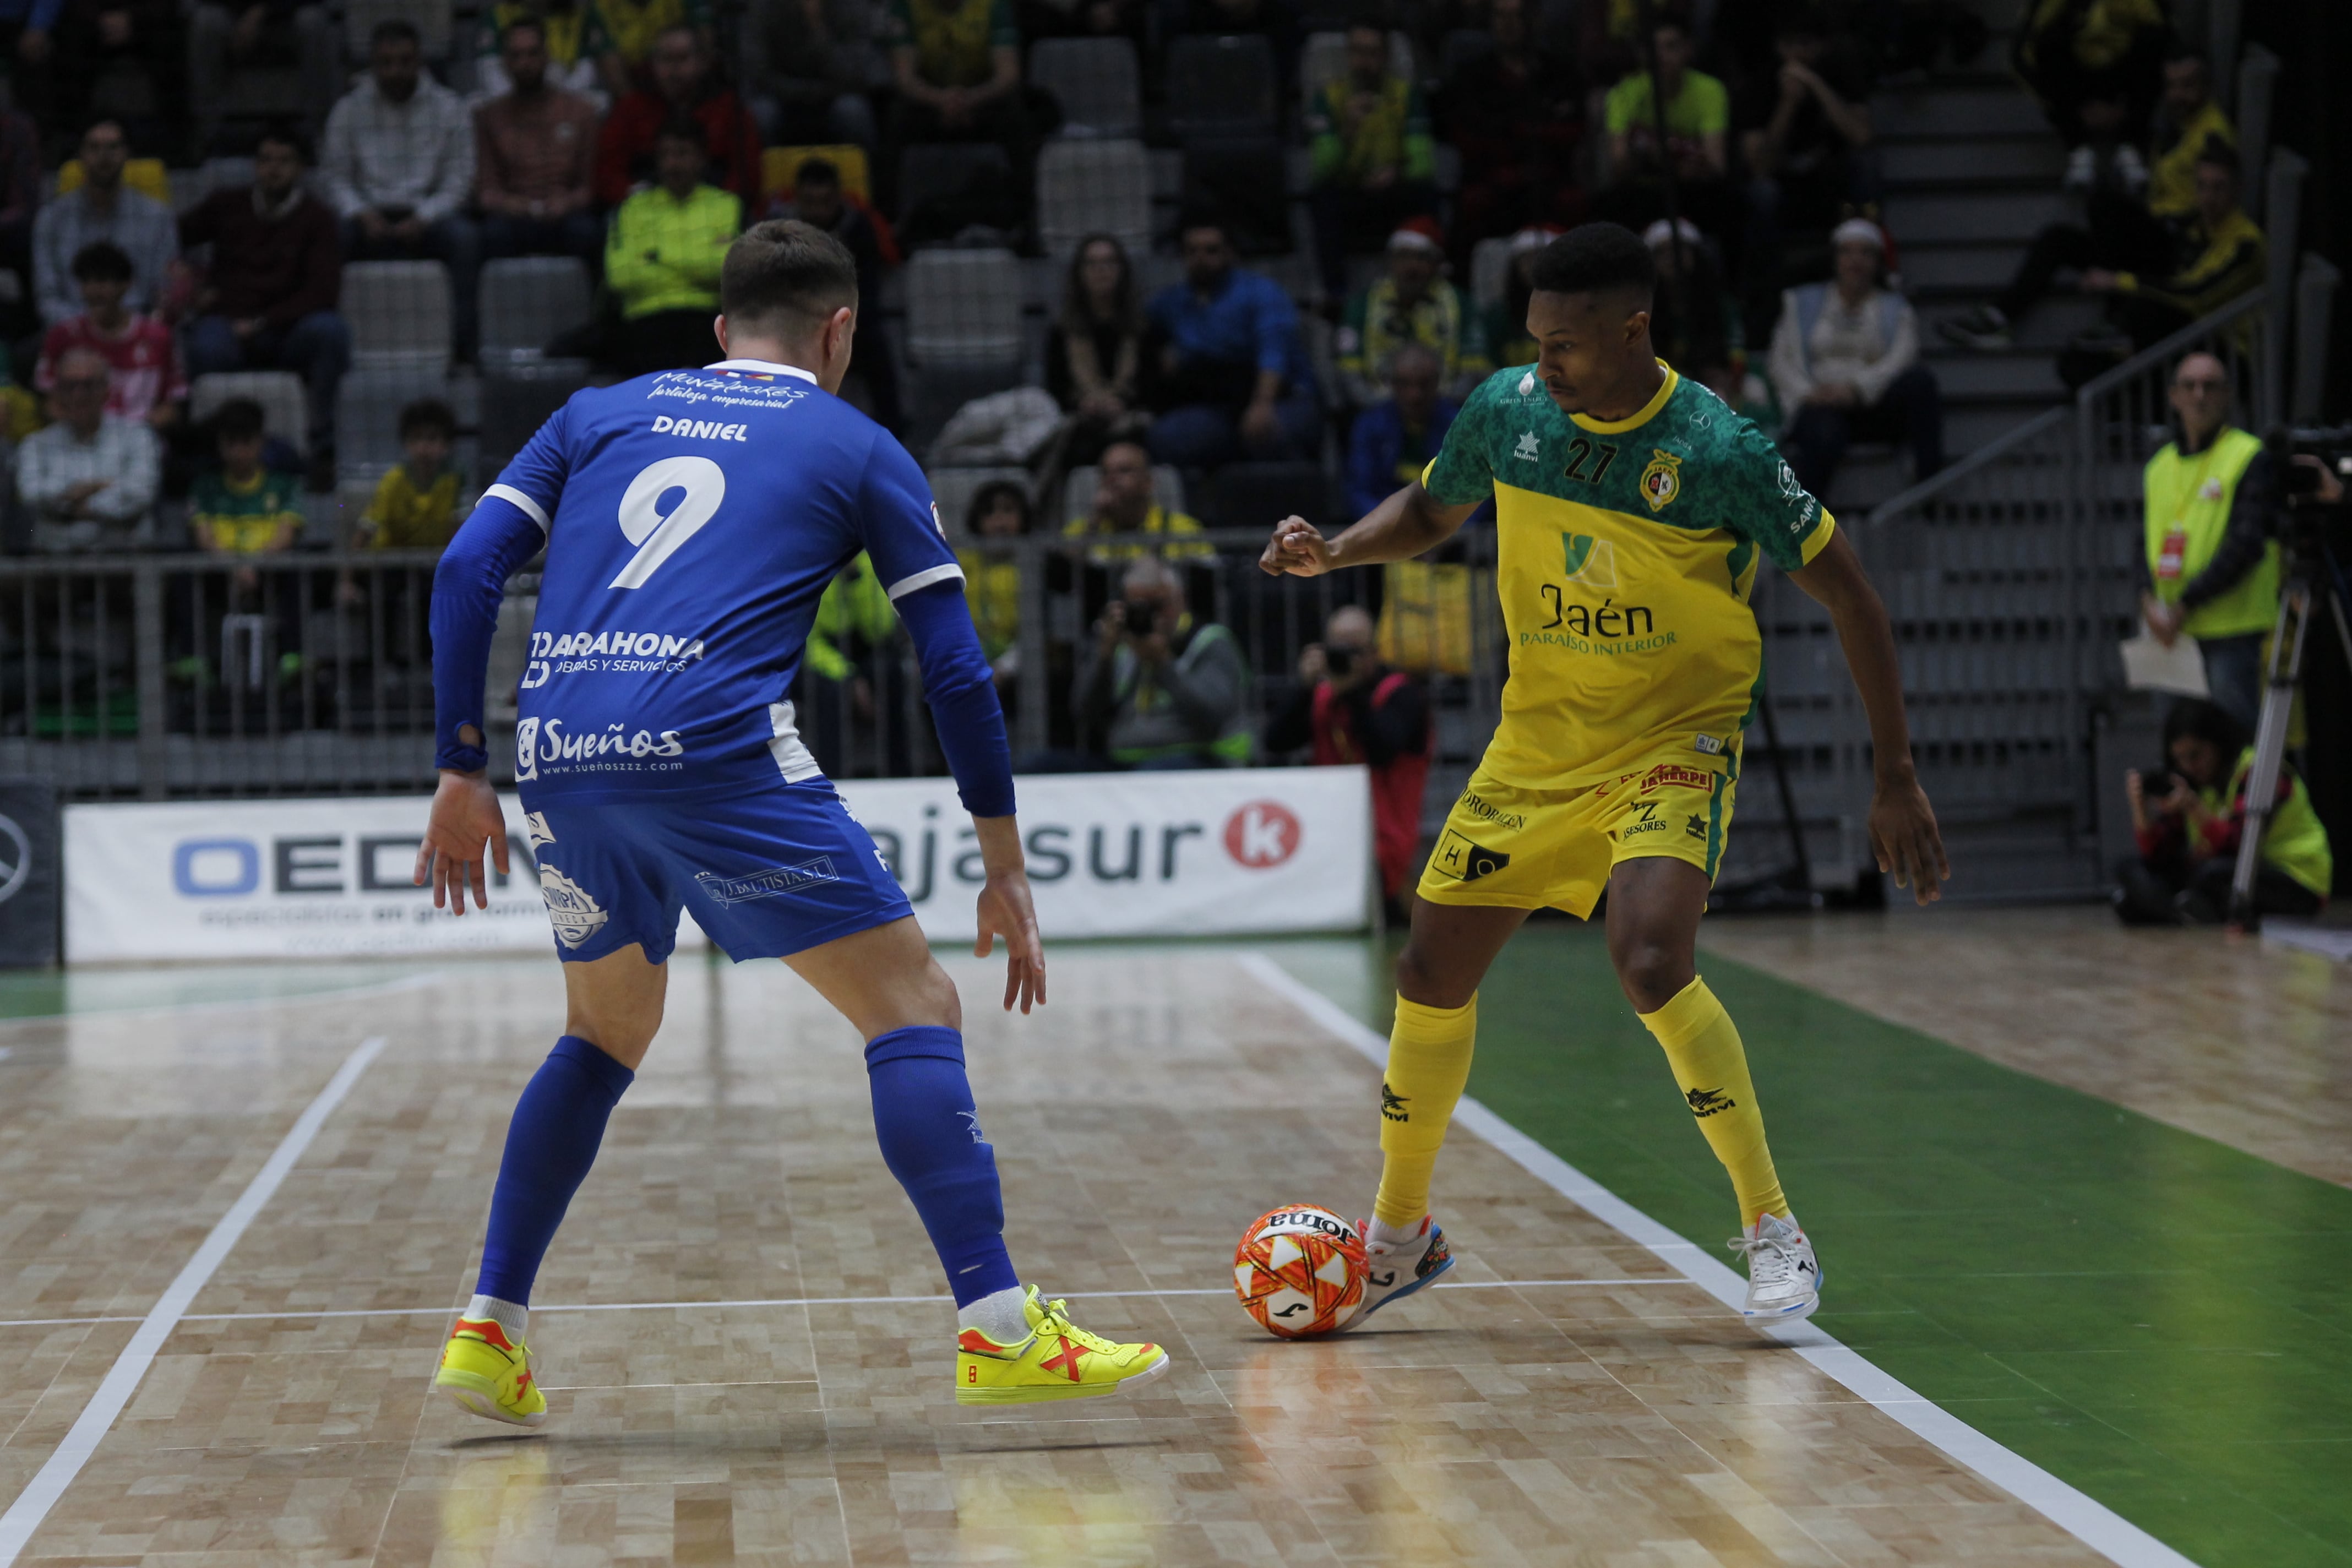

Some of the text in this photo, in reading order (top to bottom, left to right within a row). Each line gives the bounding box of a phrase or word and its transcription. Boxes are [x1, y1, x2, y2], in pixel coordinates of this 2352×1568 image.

[711, 394, 793, 409] empresarial
[651, 415, 748, 442] DANIEL
[1514, 449, 1538, 462] luanvi
[1564, 437, 1619, 484] 27
[608, 456, 726, 589] 9
[1541, 584, 1653, 637] Jaén
[1520, 631, 1677, 656] PARAÍSO INTERIOR
[555, 659, 688, 673] OBRAS Y SERVICIOS
[540, 718, 684, 761] Sueños
[542, 761, 683, 775] www.sueñoszzz.com
[1624, 820, 1667, 841] ASESORES
[1268, 1212, 1353, 1245] Joma
